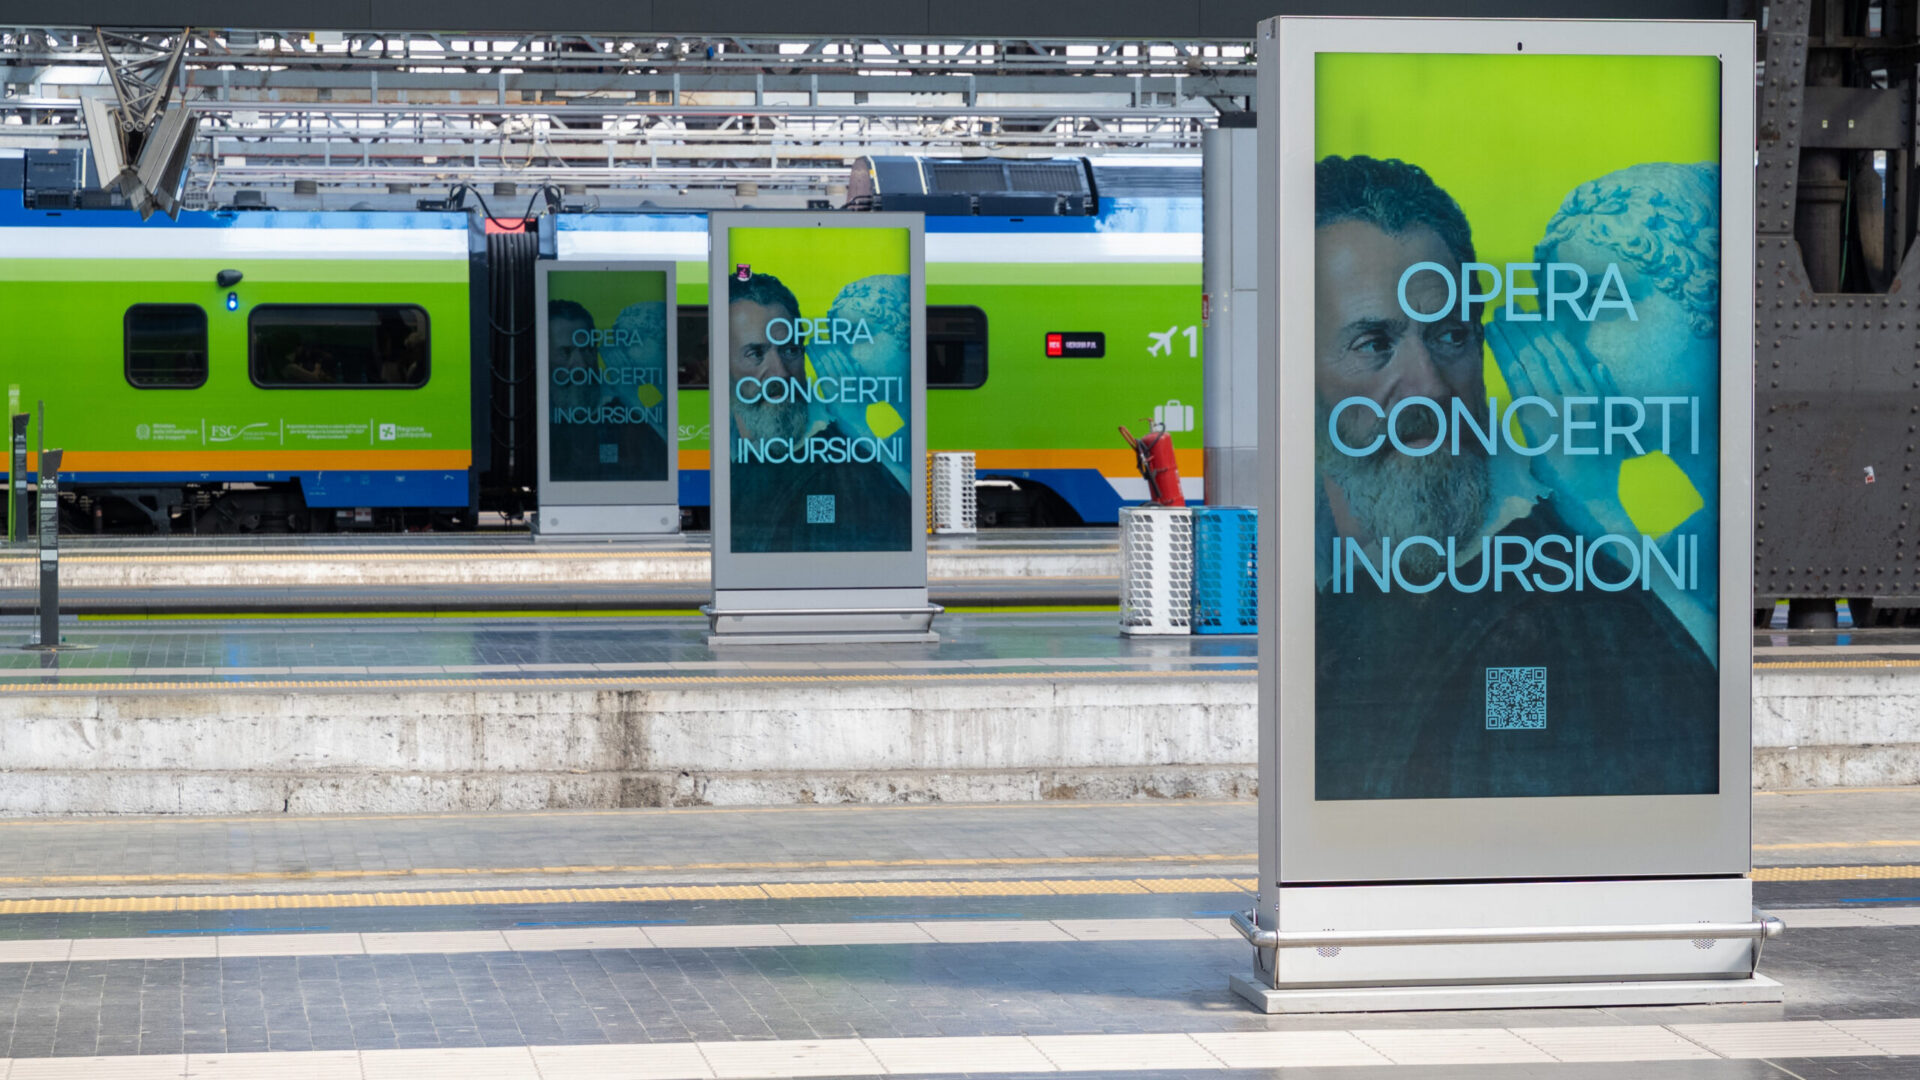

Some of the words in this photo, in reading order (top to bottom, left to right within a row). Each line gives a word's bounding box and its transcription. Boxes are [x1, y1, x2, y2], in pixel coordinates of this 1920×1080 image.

[1397, 261, 1639, 323] OPERA
[572, 328, 644, 348] OPERA
[765, 317, 874, 346] OPERA
[1182, 325, 1197, 358] 1
[552, 366, 663, 386] CONCERTI
[735, 376, 903, 404] CONCERTI
[554, 406, 663, 424] INCURSIONI
[1328, 395, 1700, 458] CONCERTI
[211, 425, 237, 437] FSC
[738, 436, 903, 463] INCURSIONI
[1332, 533, 1698, 594] INCURSIONI
